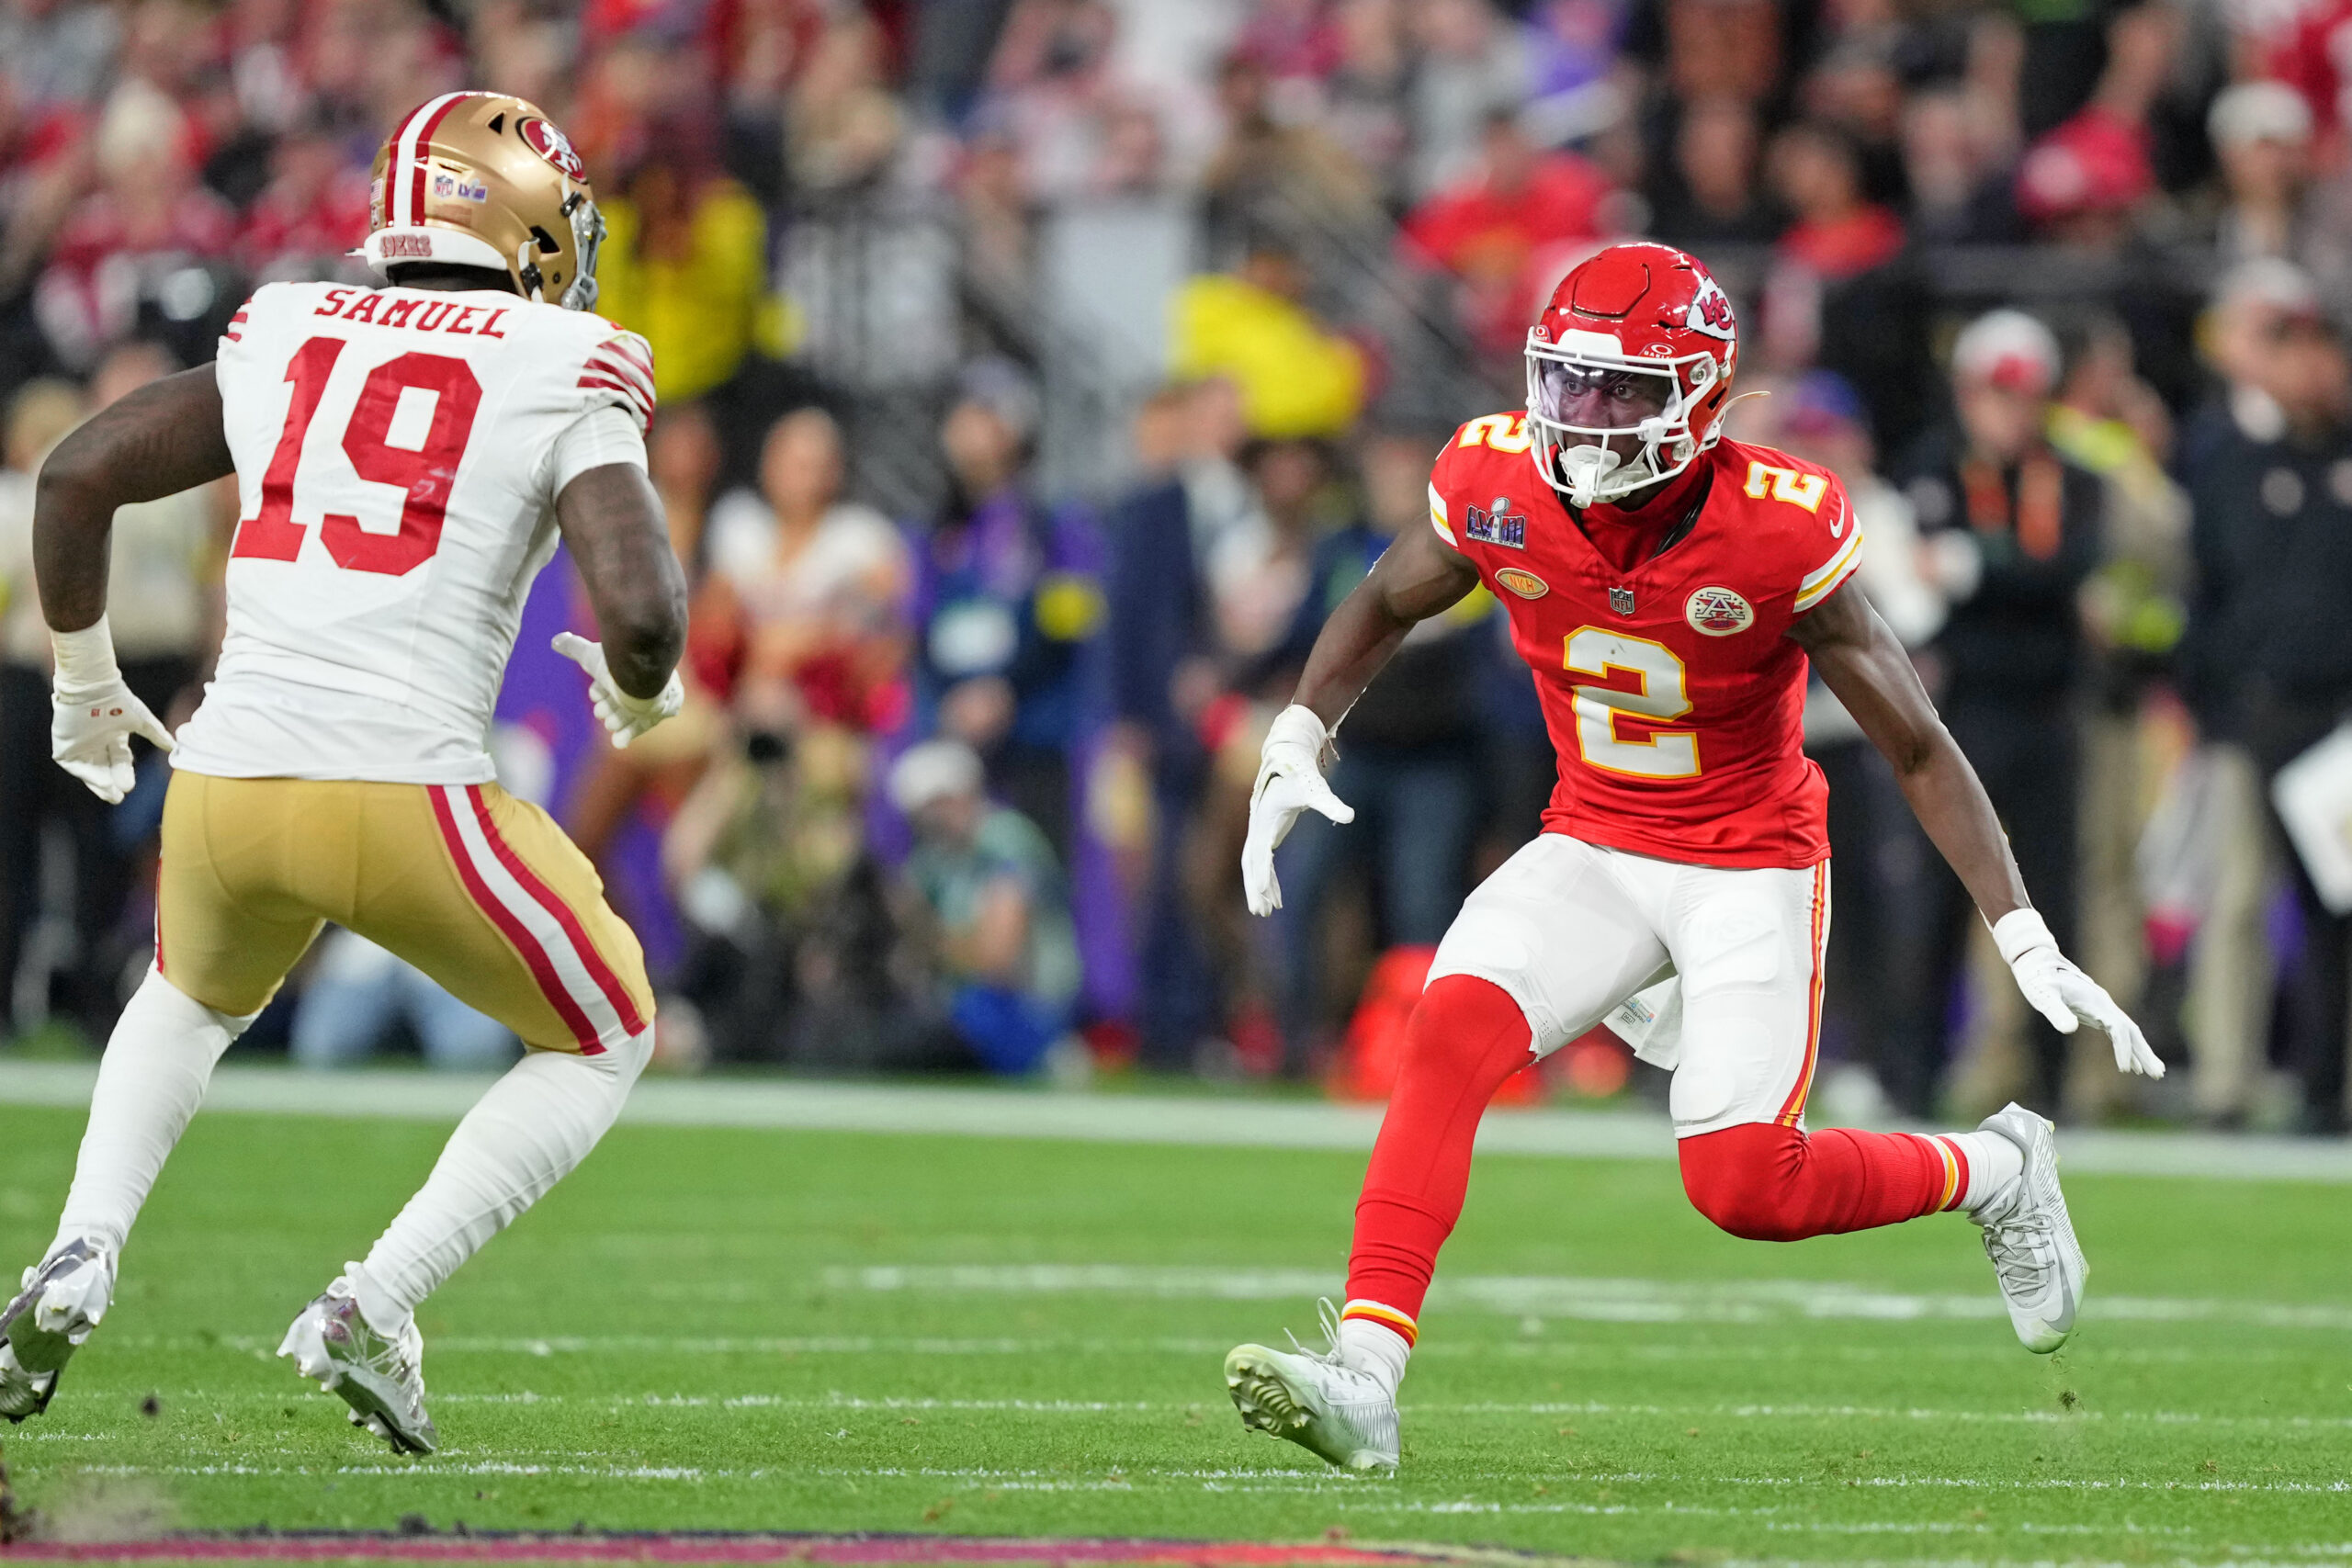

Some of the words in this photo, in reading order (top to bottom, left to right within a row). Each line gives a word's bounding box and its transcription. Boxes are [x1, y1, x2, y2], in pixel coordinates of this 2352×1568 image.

[380, 235, 432, 258] 49ERS
[313, 289, 510, 339] SAMUEL
[1698, 290, 1734, 331] KC
[1458, 413, 1534, 455] 2
[232, 336, 483, 577] 19
[1744, 461, 1827, 513] 2
[1508, 574, 1535, 592] NKH
[1613, 599, 1631, 611] NFL
[1564, 625, 1702, 779] 2
